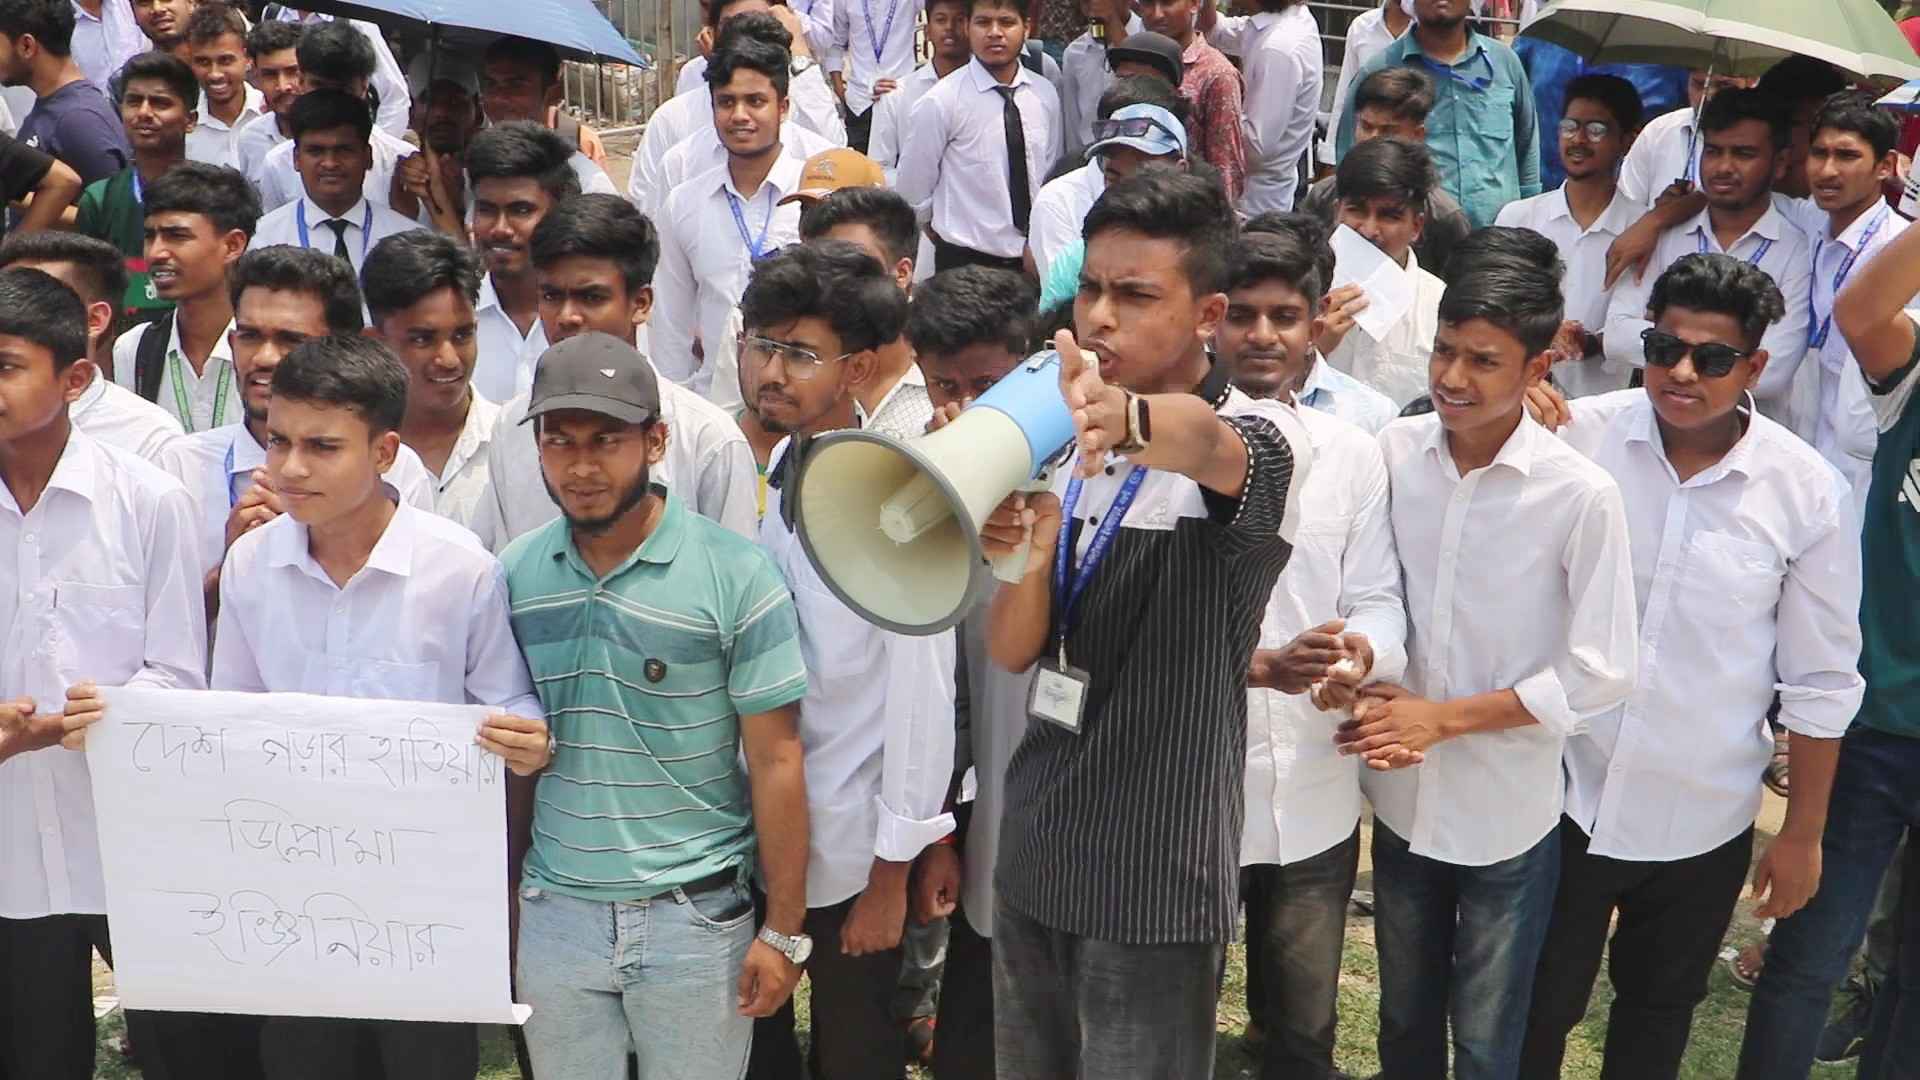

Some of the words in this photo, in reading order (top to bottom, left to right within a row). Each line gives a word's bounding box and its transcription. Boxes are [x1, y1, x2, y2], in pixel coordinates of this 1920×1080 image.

[122, 721, 227, 776] দেশ
[262, 730, 350, 783] গড়ার
[200, 798, 437, 865] ডিপ্লোমা
